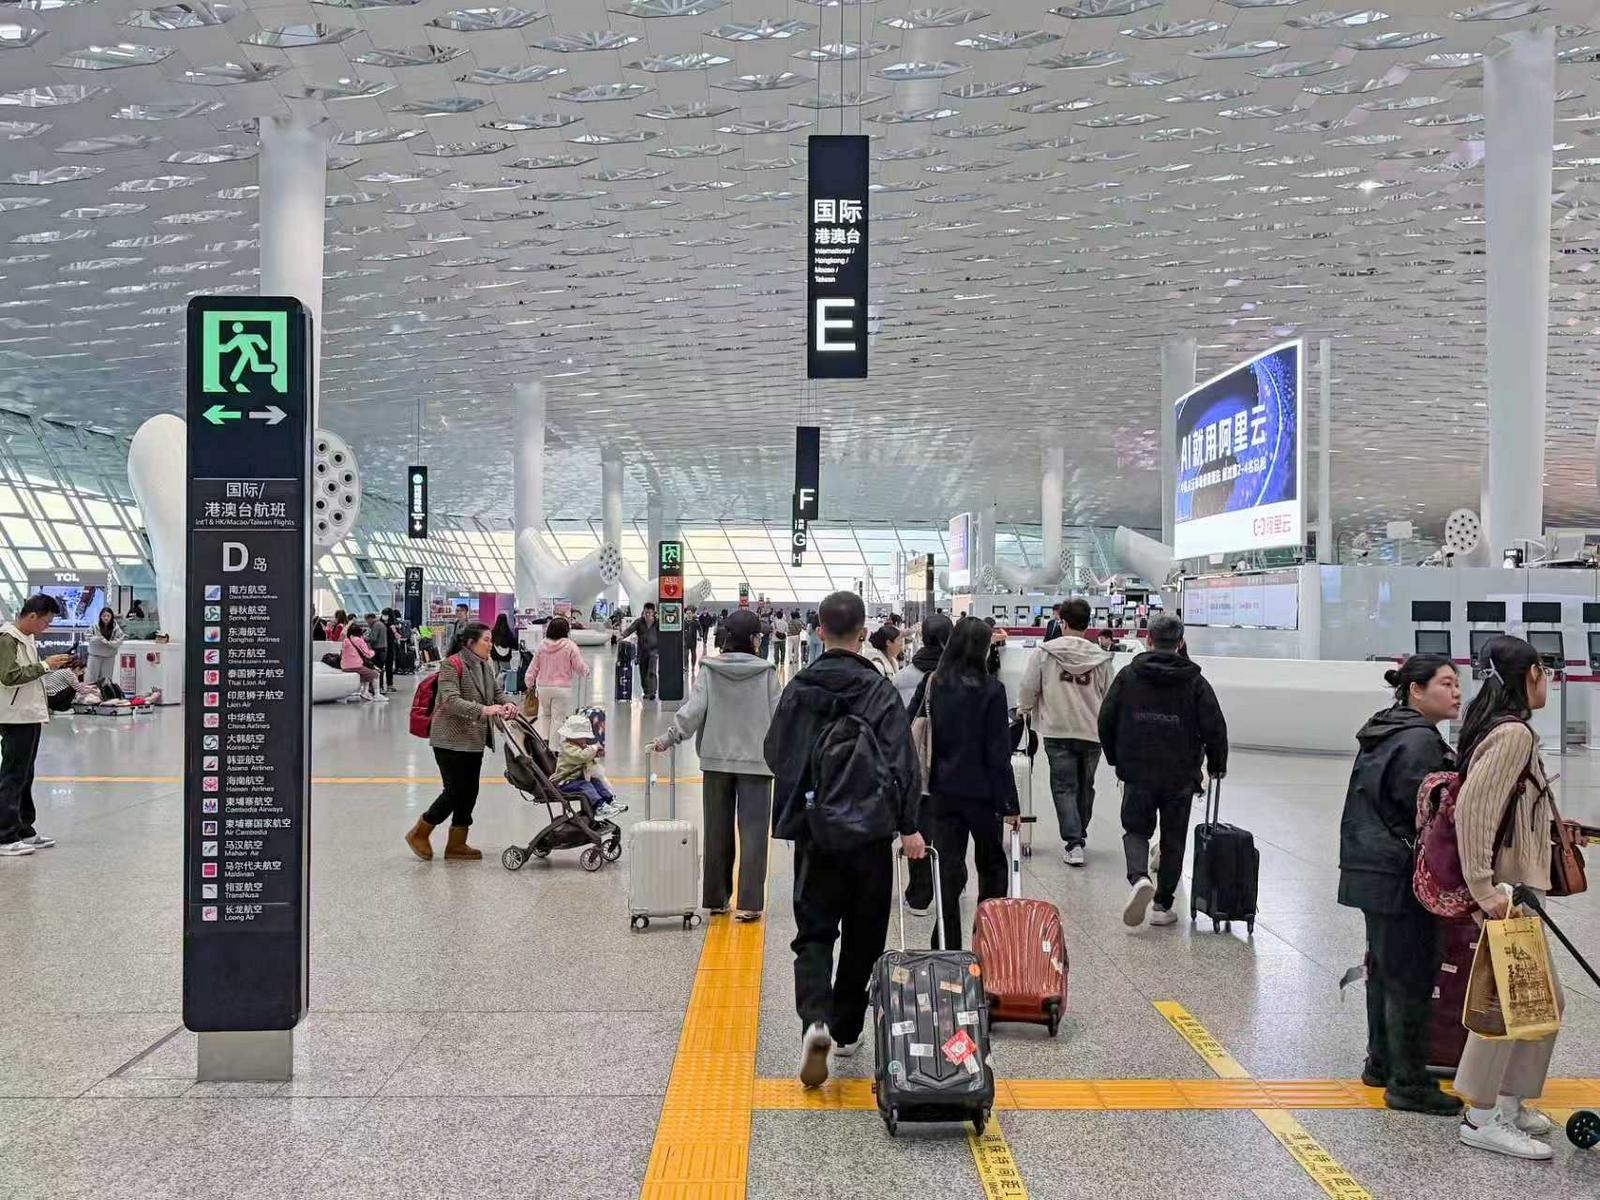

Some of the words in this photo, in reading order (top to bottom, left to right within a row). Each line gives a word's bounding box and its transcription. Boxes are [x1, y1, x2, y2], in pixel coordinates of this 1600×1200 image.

[814, 199, 863, 223] 国际
[815, 228, 861, 244] 港澳台
[816, 298, 856, 351] E
[1180, 405, 1267, 472] AI就用阿里云
[226, 482, 265, 498] 国际/
[799, 488, 815, 511] F
[204, 502, 286, 518] 港澳台航班
[273, 519, 295, 527] Flights
[794, 532, 806, 547] G
[222, 541, 249, 572] D
[253, 557, 267, 572] 岛
[793, 552, 801, 564] H
[54, 572, 80, 582] TCL
[229, 585, 267, 594] 南方航空
[229, 605, 267, 615] 春秋航空
[228, 627, 267, 636] 东海航空
[228, 648, 266, 658] 东方航空
[228, 668, 285, 678] 泰国狮子航空
[227, 690, 284, 700] 印尼狮子航空
[227, 713, 265, 722] 中华航空
[226, 734, 265, 743] 大韩航空
[226, 776, 265, 786] 海南航空
[225, 840, 263, 850] 马汉航空
[225, 861, 281, 871] 马尔代夫航空
